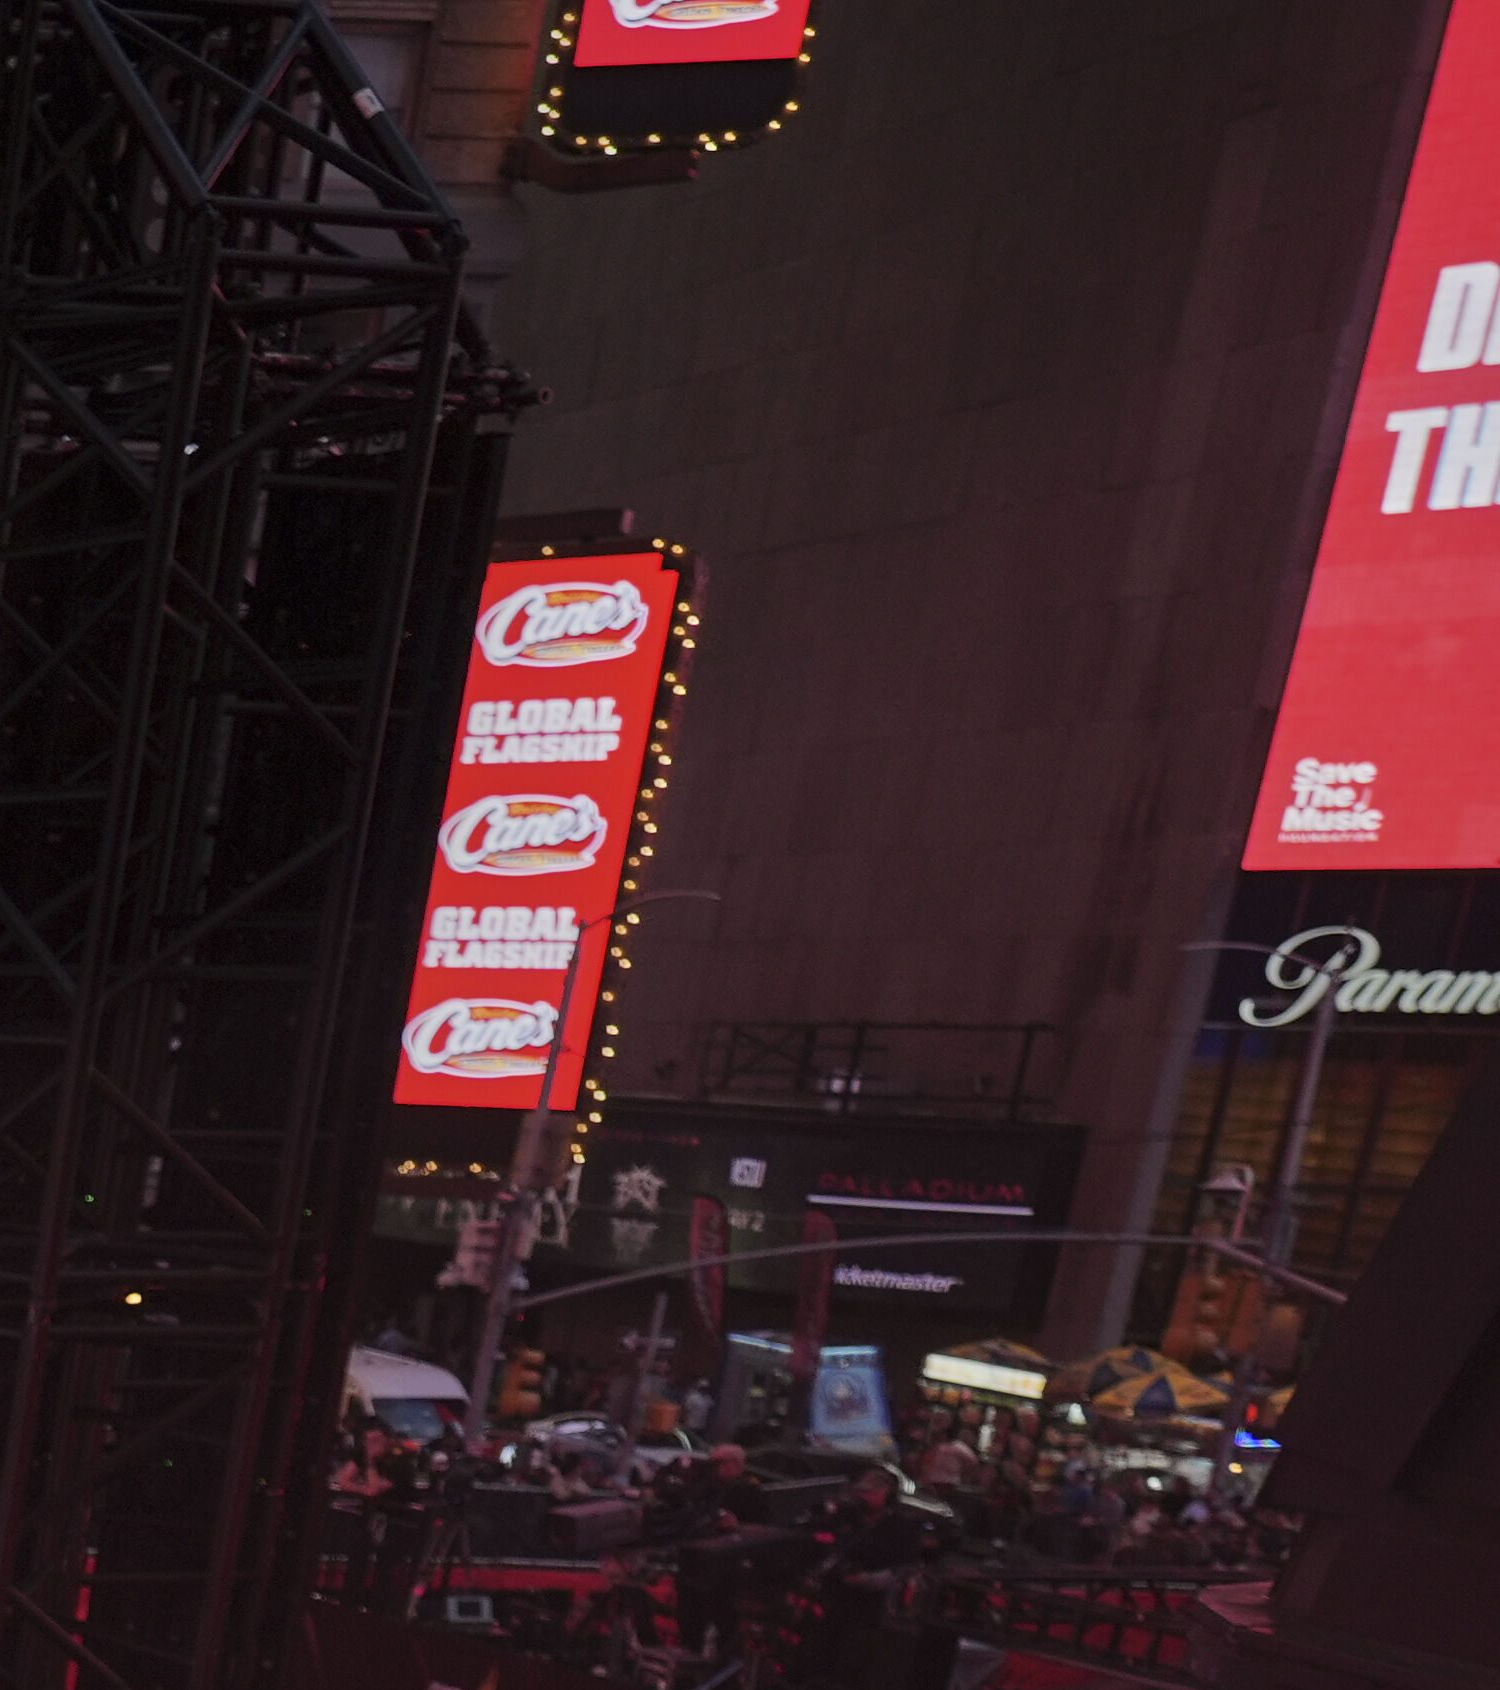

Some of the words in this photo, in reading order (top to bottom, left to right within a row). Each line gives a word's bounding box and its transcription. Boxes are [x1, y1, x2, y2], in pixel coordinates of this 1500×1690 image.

[1381, 401, 1500, 515] TH
[467, 698, 622, 736] GLOBAL
[461, 733, 619, 765] FLAGSHIP
[1294, 757, 1377, 785] Save
[1291, 782, 1357, 808] The
[1281, 804, 1384, 831] Music
[430, 906, 580, 941] GLOBAL
[423, 940, 576, 969] FLAGSHIP
